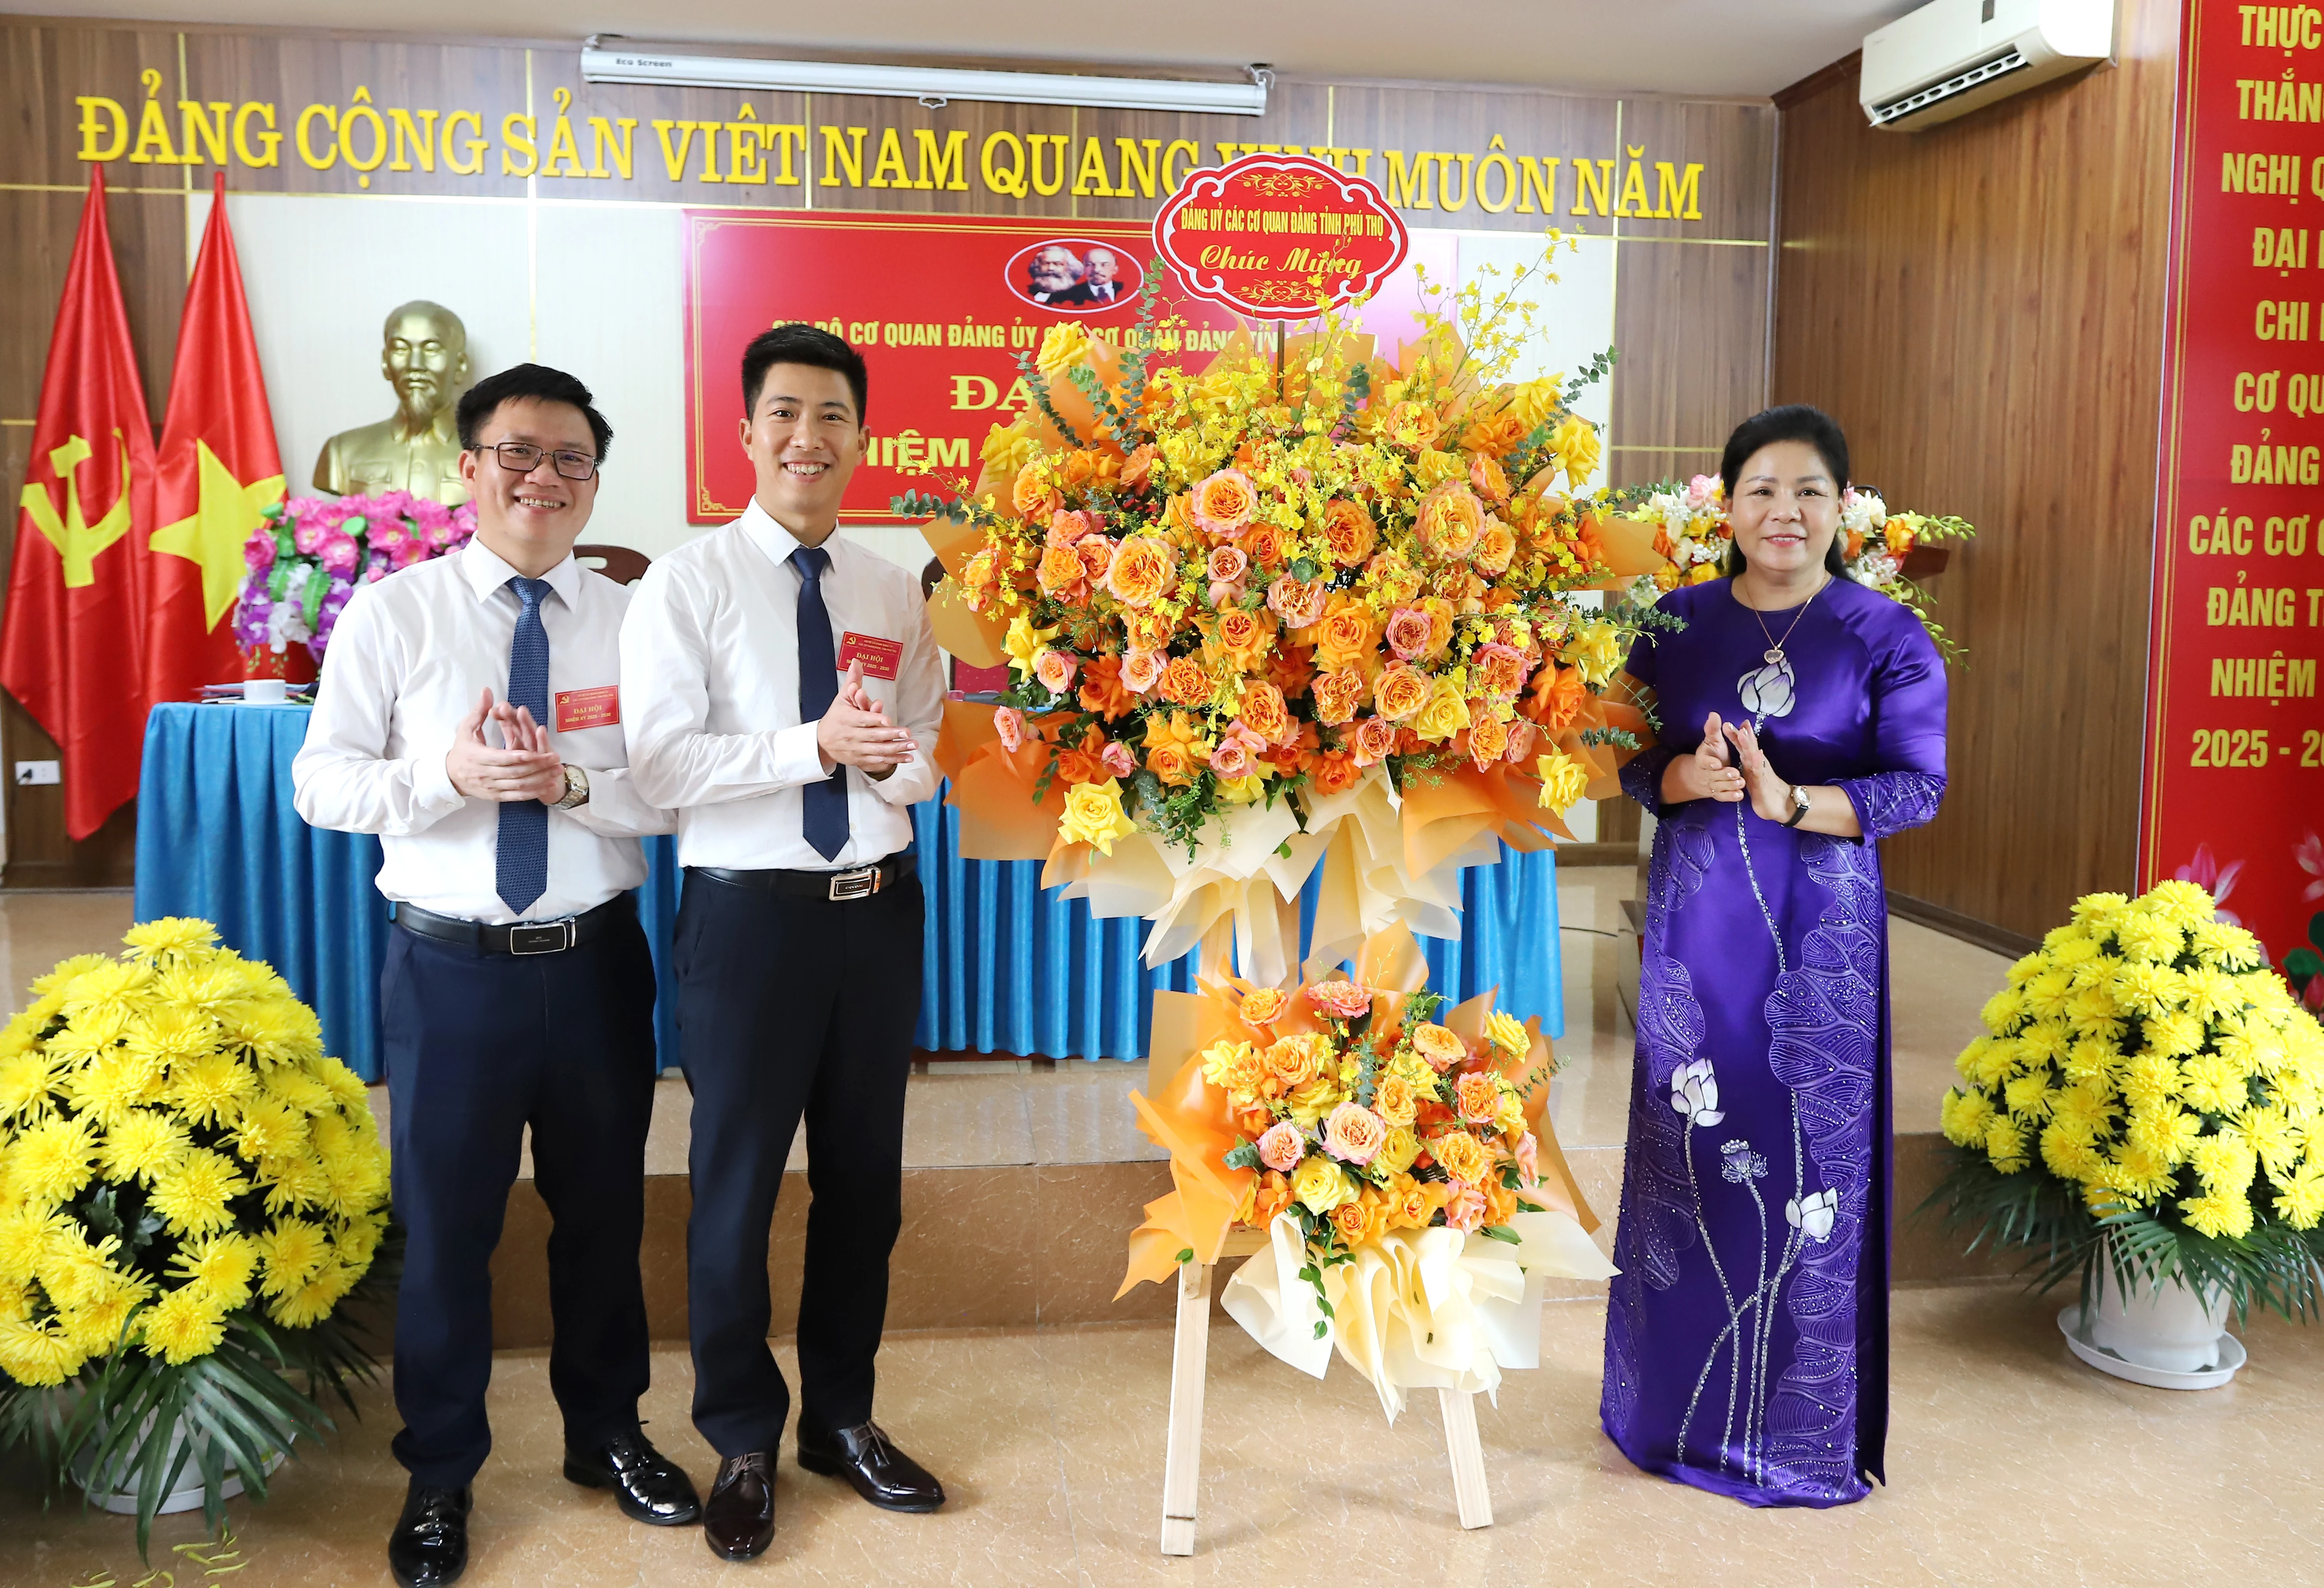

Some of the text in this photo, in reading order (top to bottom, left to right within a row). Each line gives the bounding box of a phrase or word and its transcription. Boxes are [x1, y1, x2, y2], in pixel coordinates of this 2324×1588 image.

[2237, 4, 2322, 57] THỰC
[616, 57, 633, 66] Eco
[2235, 67, 2324, 123] THẮN
[75, 67, 284, 168] ĐẢNG
[296, 85, 490, 188] CỘNG
[501, 87, 638, 180] SẢN
[819, 125, 970, 191] NAM
[981, 131, 1199, 199] QUANG
[1383, 134, 1561, 215] MUÔN
[1570, 144, 1705, 220] NĂM
[2221, 152, 2301, 205] NGHỊ
[1180, 200, 1208, 231] ĐẢNG
[1225, 204, 1245, 232] CÁC
[1247, 208, 1261, 232] CƠ
[1262, 211, 1289, 235] QUAN
[1290, 204, 1317, 234] ĐẢNG
[1319, 205, 1341, 235] TỈNH
[1343, 209, 1364, 236] PHÚ
[1365, 214, 1384, 241] THỌ
[1200, 245, 1270, 271] Chúc
[2253, 227, 2309, 277] ĐẠI
[849, 320, 880, 345] CƠ
[884, 323, 942, 348] QUAN
[947, 315, 1006, 348] ĐẢNG
[1011, 316, 1038, 348] ỦY
[1185, 320, 1236, 352] ĐẢN
[2256, 300, 2310, 341] CHI
[2234, 370, 2281, 414] CƠ
[2230, 427, 2320, 485] ĐẢNG
[2189, 507, 2254, 556] CÁC
[2264, 514, 2310, 557] CƠ
[2207, 570, 2296, 627] ĐẢNG
[856, 652, 884, 663] ĐẠI HỘI
[2210, 650, 2317, 706] NHIỆM
[2190, 729, 2269, 768] 2025
[2301, 729, 2324, 768] 2
